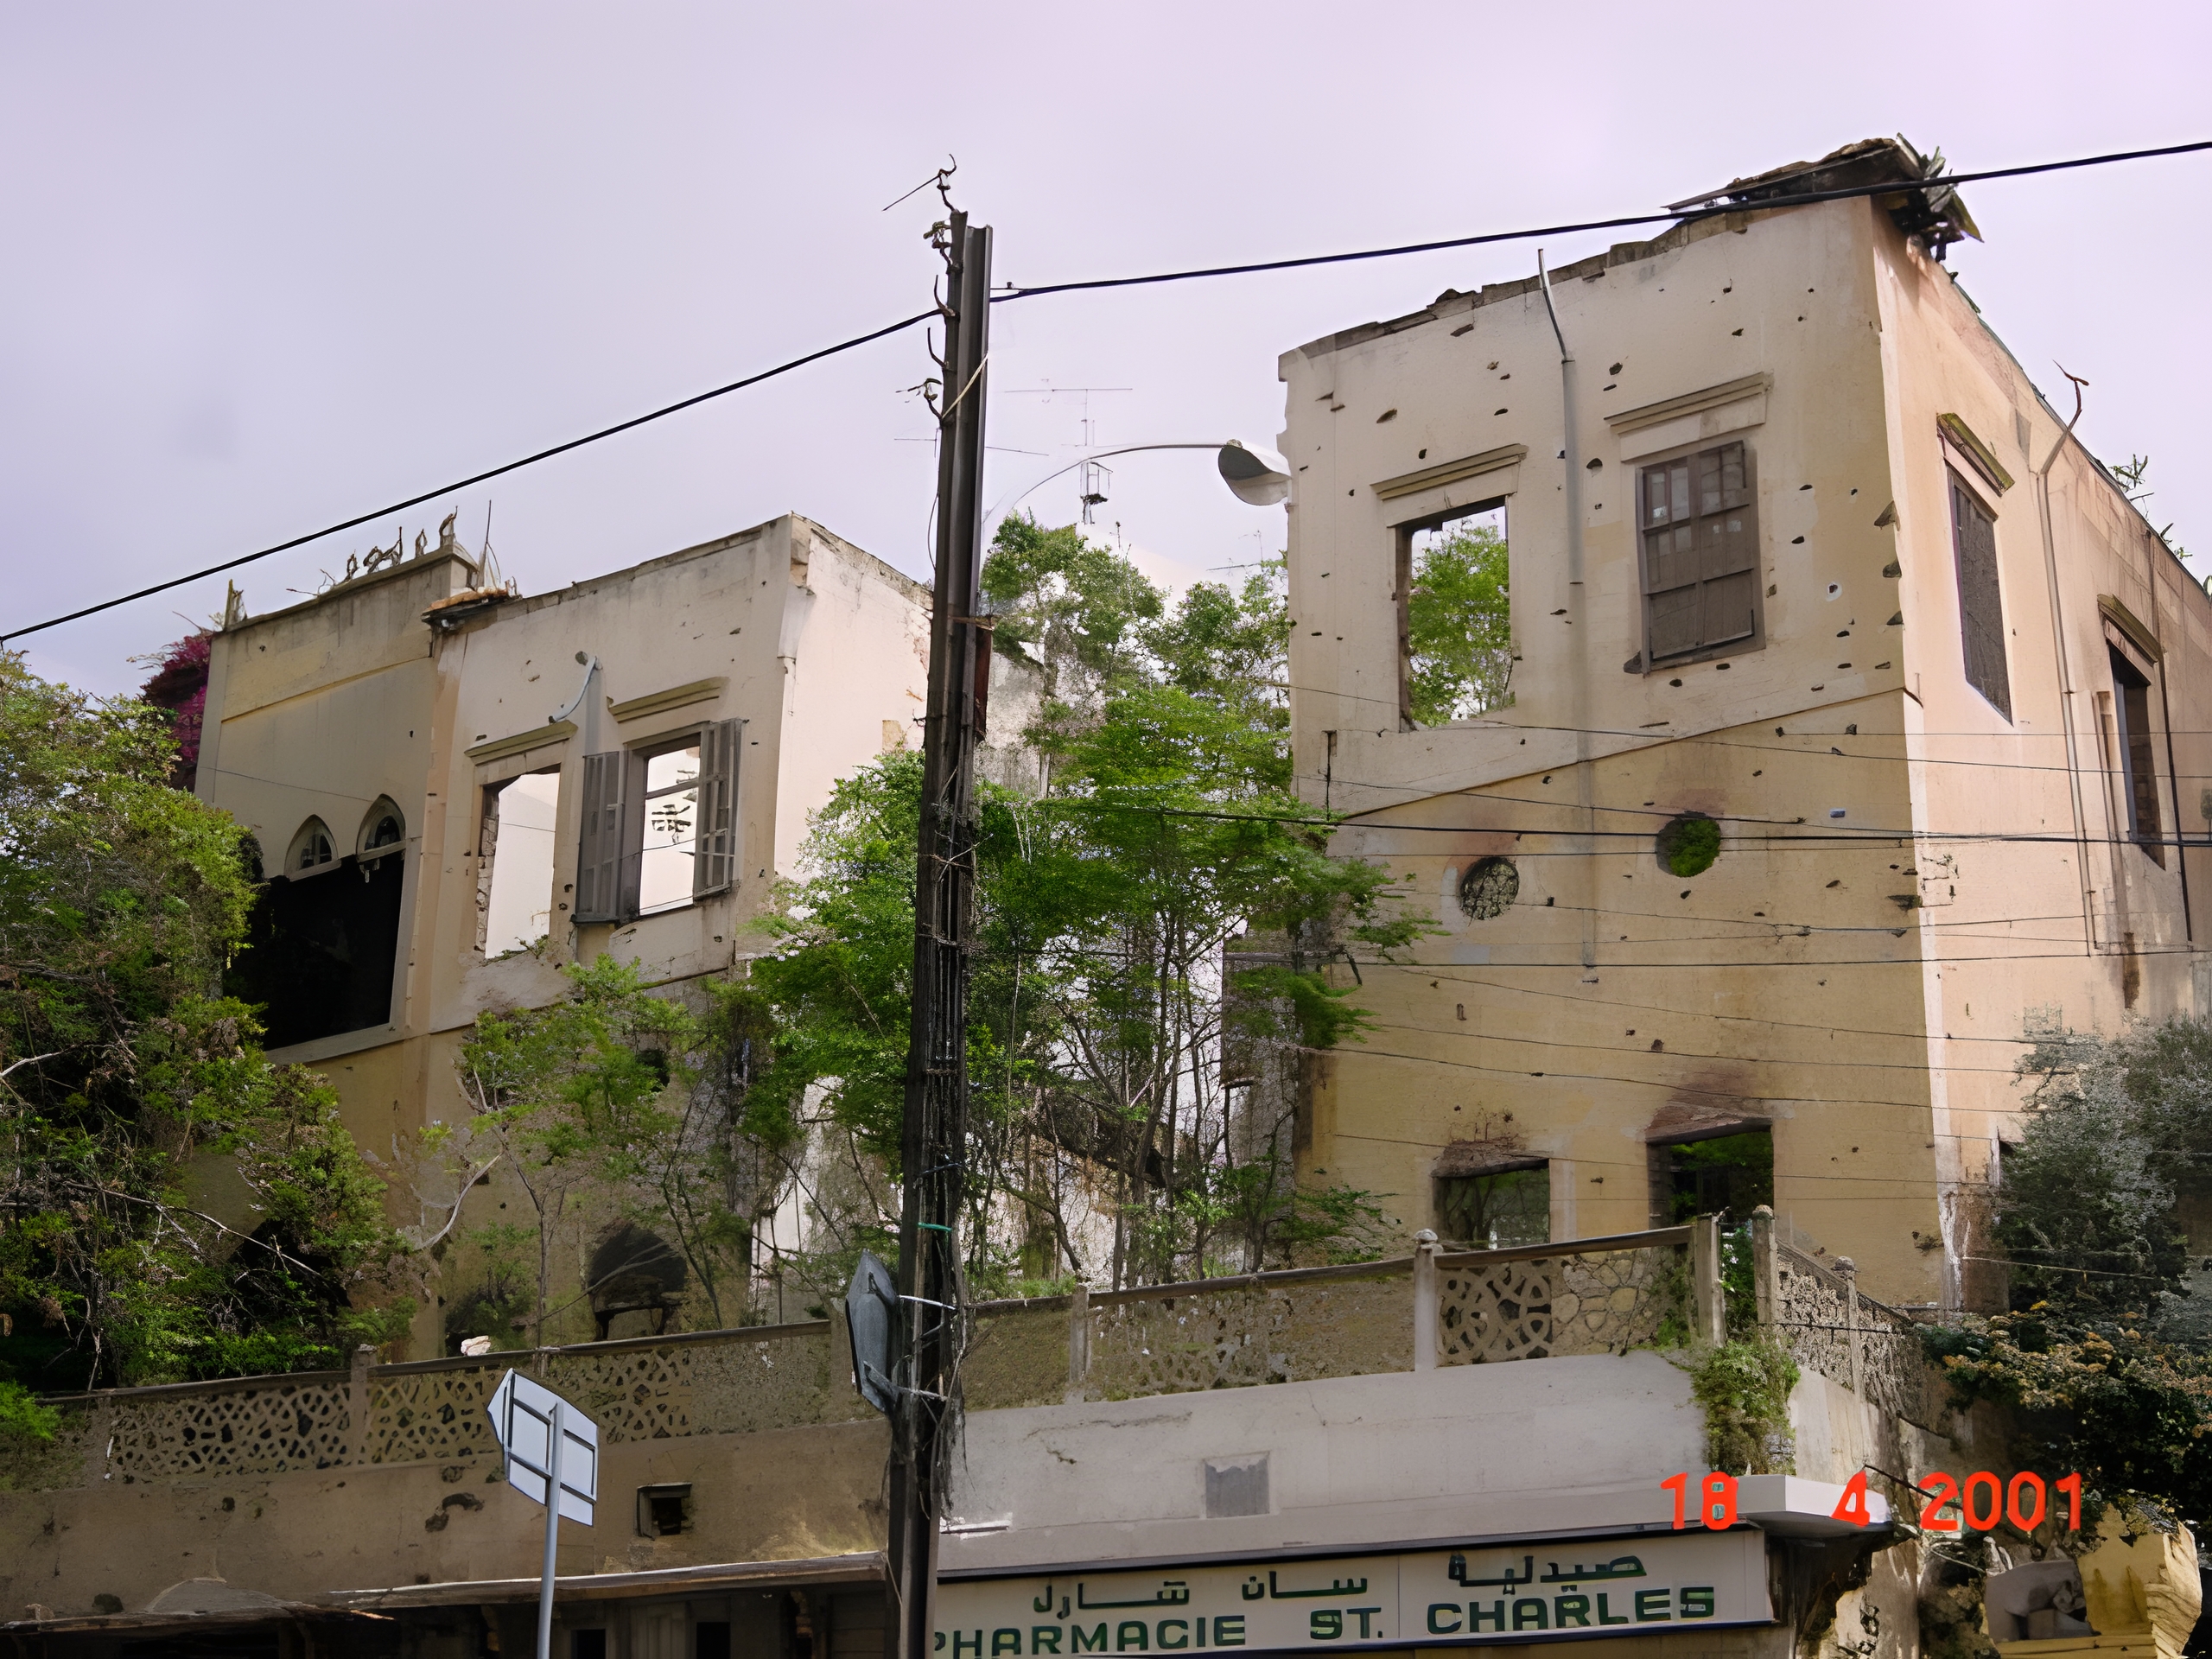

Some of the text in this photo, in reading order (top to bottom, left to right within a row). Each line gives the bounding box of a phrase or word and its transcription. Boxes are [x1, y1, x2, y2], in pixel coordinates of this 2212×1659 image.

[1242, 1570, 1368, 1600] سان
[1310, 1606, 1383, 1640] ST.
[1427, 1586, 1715, 1635] CHARLES
